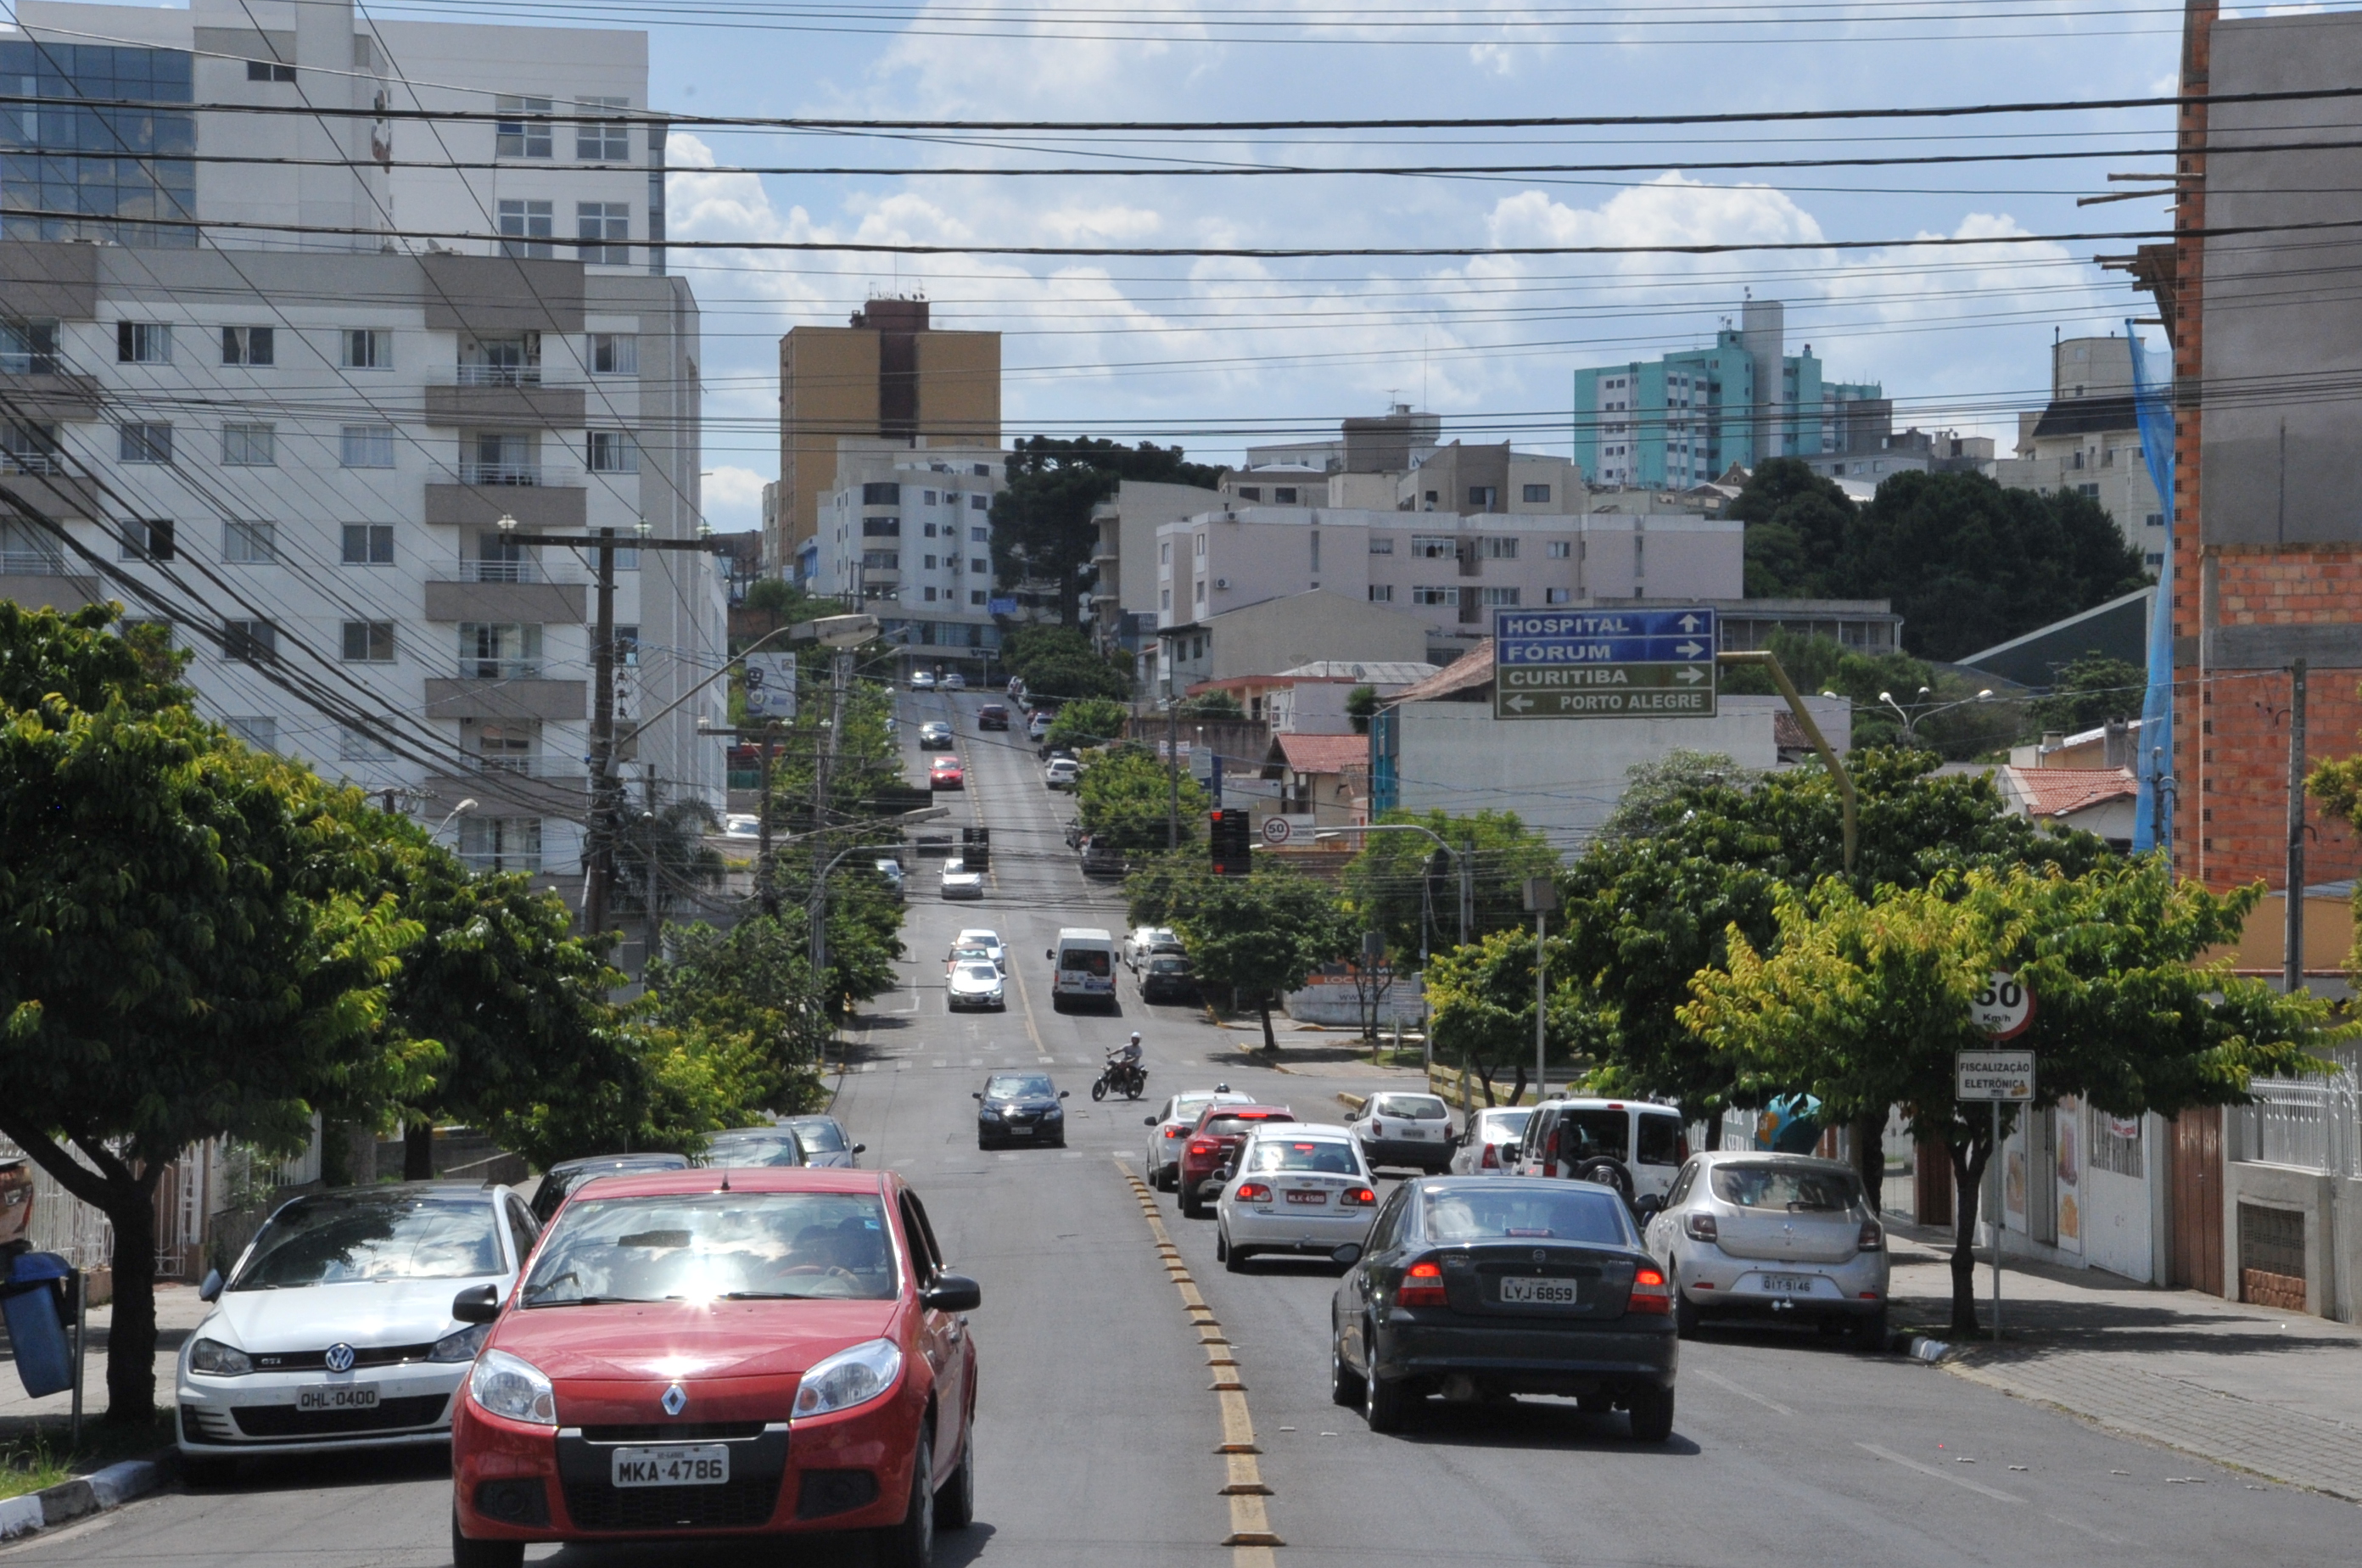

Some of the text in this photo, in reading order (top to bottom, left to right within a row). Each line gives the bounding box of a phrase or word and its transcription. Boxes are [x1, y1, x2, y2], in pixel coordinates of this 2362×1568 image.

[1507, 618, 1630, 634] HOSPITAL
[1508, 642, 1611, 660] FÓRUM
[1508, 669, 1628, 686] CURITIBA
[1560, 693, 1702, 710] PORTO ALEGRE
[1268, 823, 1285, 834] 50
[1975, 981, 2022, 1008] 50
[1983, 1013, 2012, 1022] Km/h
[1960, 1061, 2030, 1074] FISCALIZAÇÃO
[1964, 1078, 2026, 1089] ELETRÔNICA
